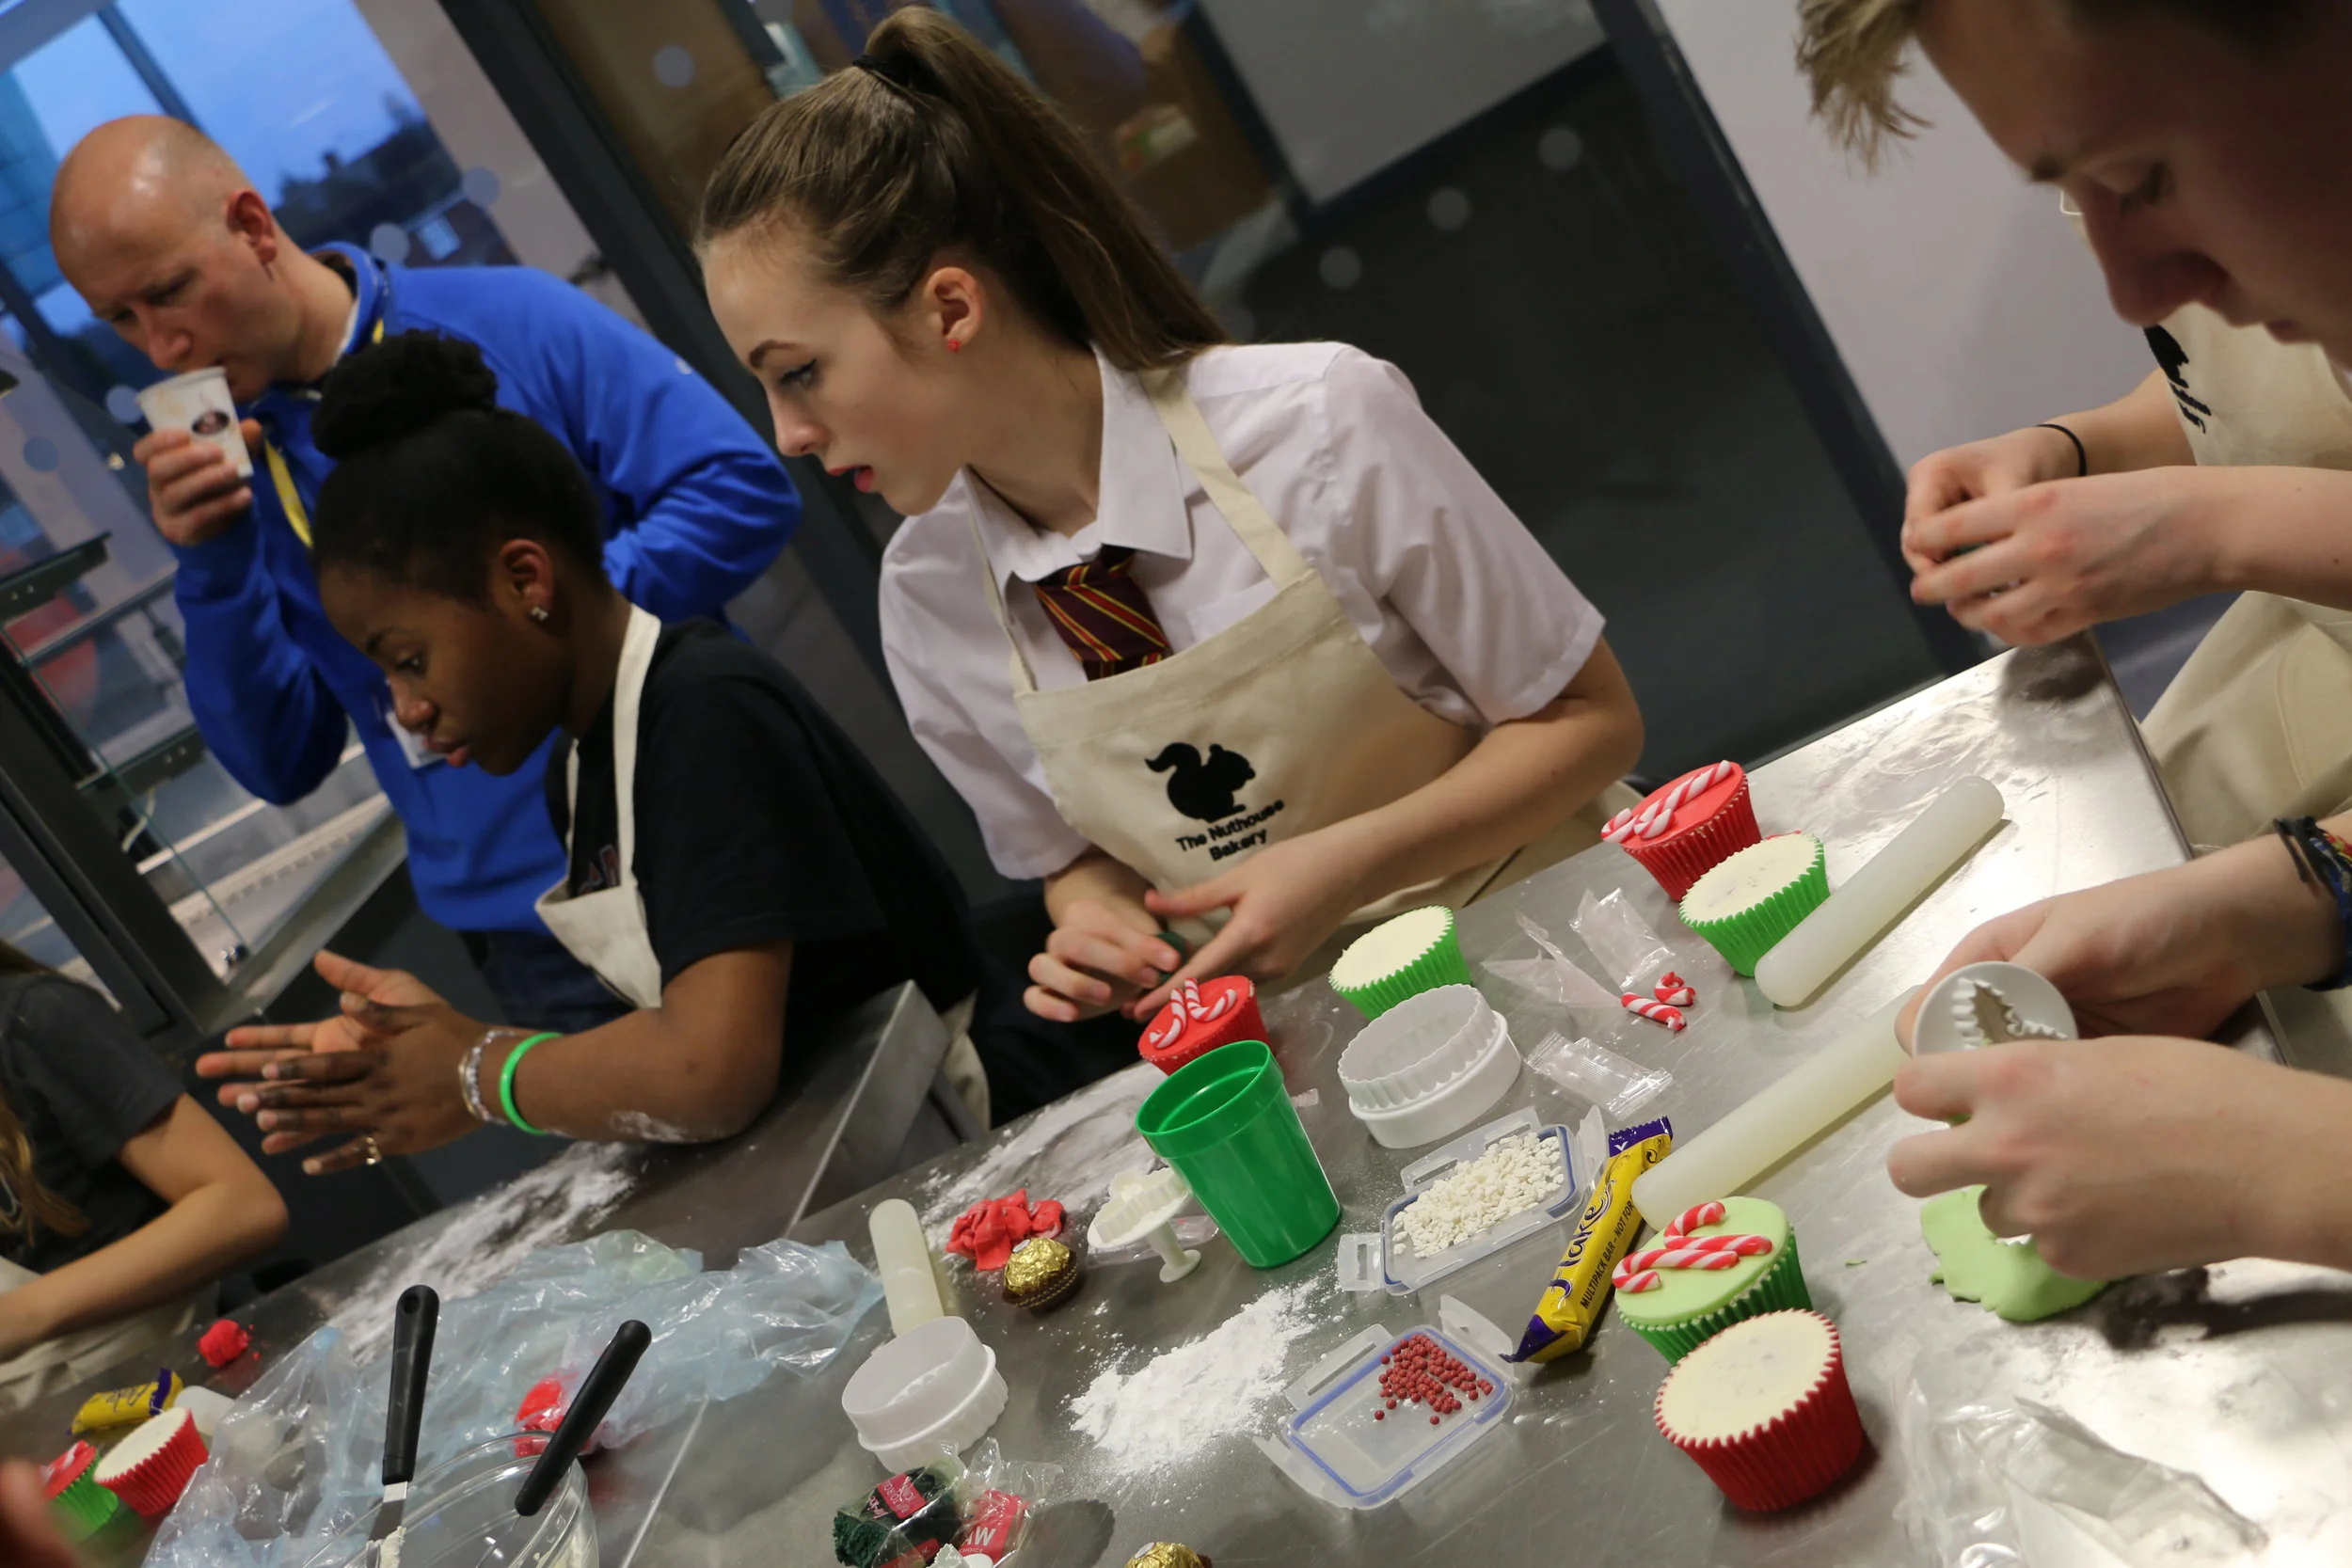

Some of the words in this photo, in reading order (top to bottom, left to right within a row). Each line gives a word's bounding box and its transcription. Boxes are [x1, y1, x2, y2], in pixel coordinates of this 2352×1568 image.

[1175, 834, 1207, 851] The
[1207, 800, 1284, 841] Nuthouse
[1209, 829, 1266, 861] Bakery
[1580, 1257, 1608, 1309] MULTIPACK
[1602, 1241, 1615, 1262] BAR
[1613, 1218, 1628, 1238] NOT
[1622, 1200, 1635, 1220] FOR
